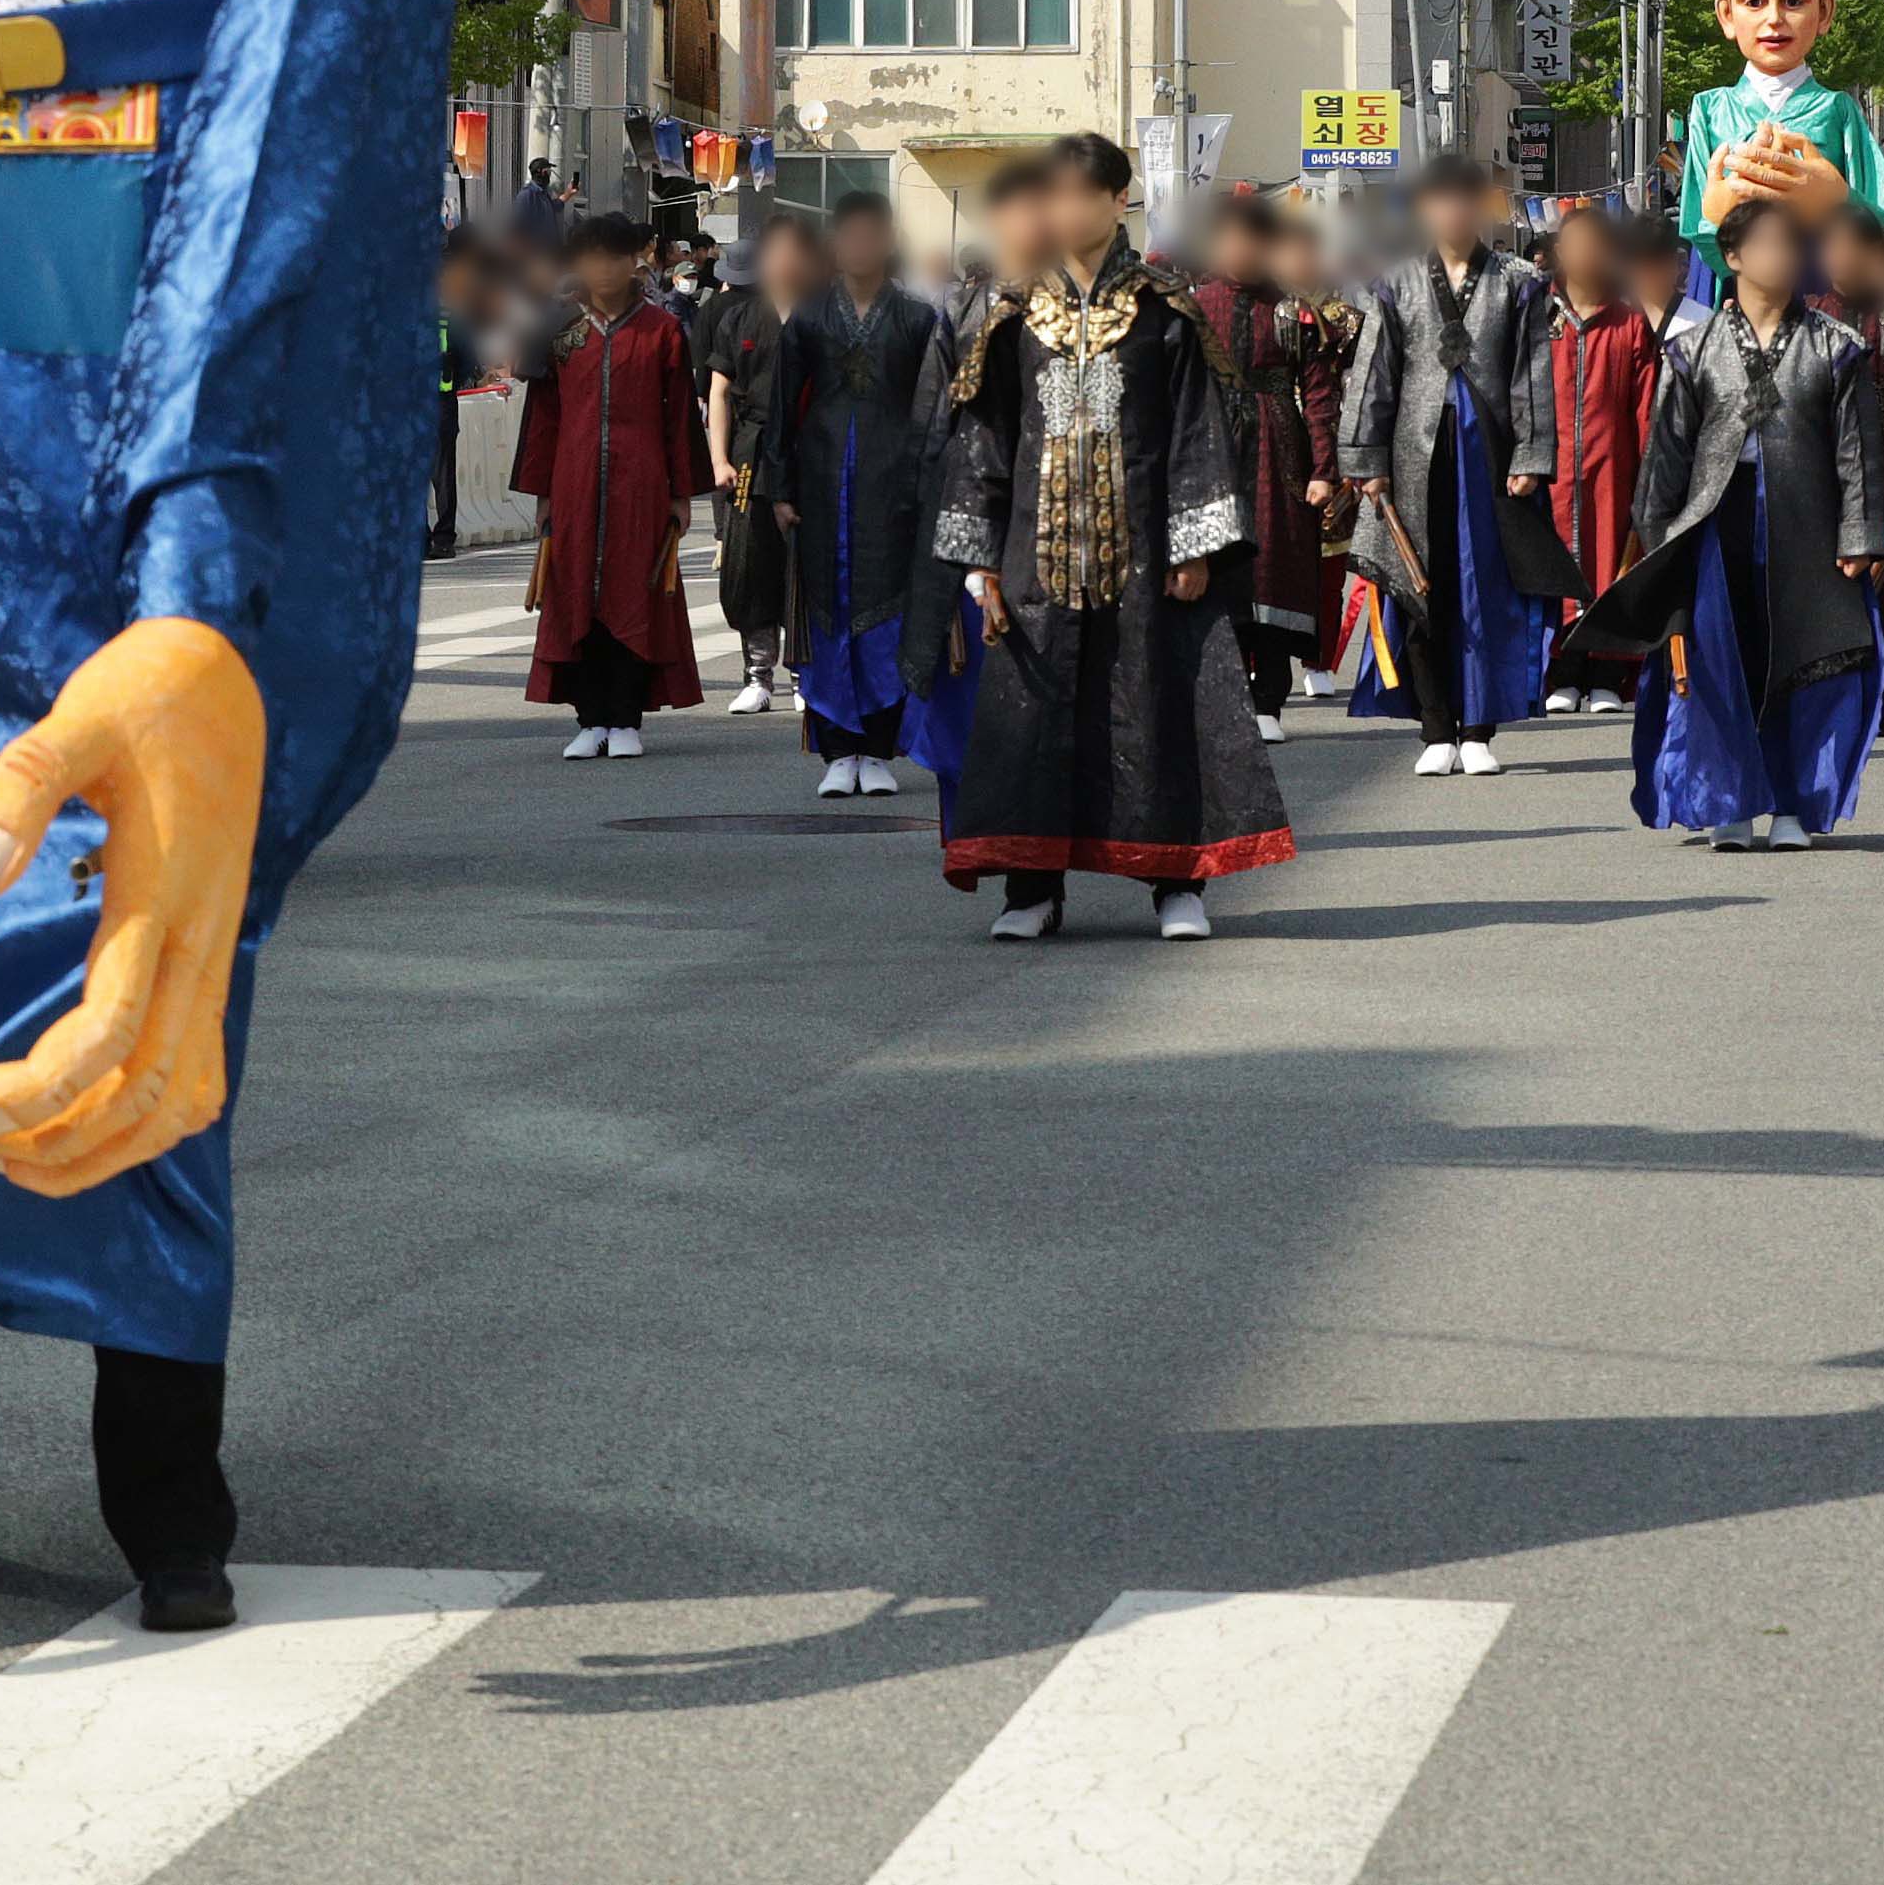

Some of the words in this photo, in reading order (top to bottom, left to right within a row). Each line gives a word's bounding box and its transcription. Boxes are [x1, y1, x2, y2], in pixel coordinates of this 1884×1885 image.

[1531, 4, 1563, 77] 사진관
[1313, 95, 1344, 145] 열쇠
[1356, 96, 1389, 146] 도장
[1311, 150, 1392, 166] 041)545-8625
